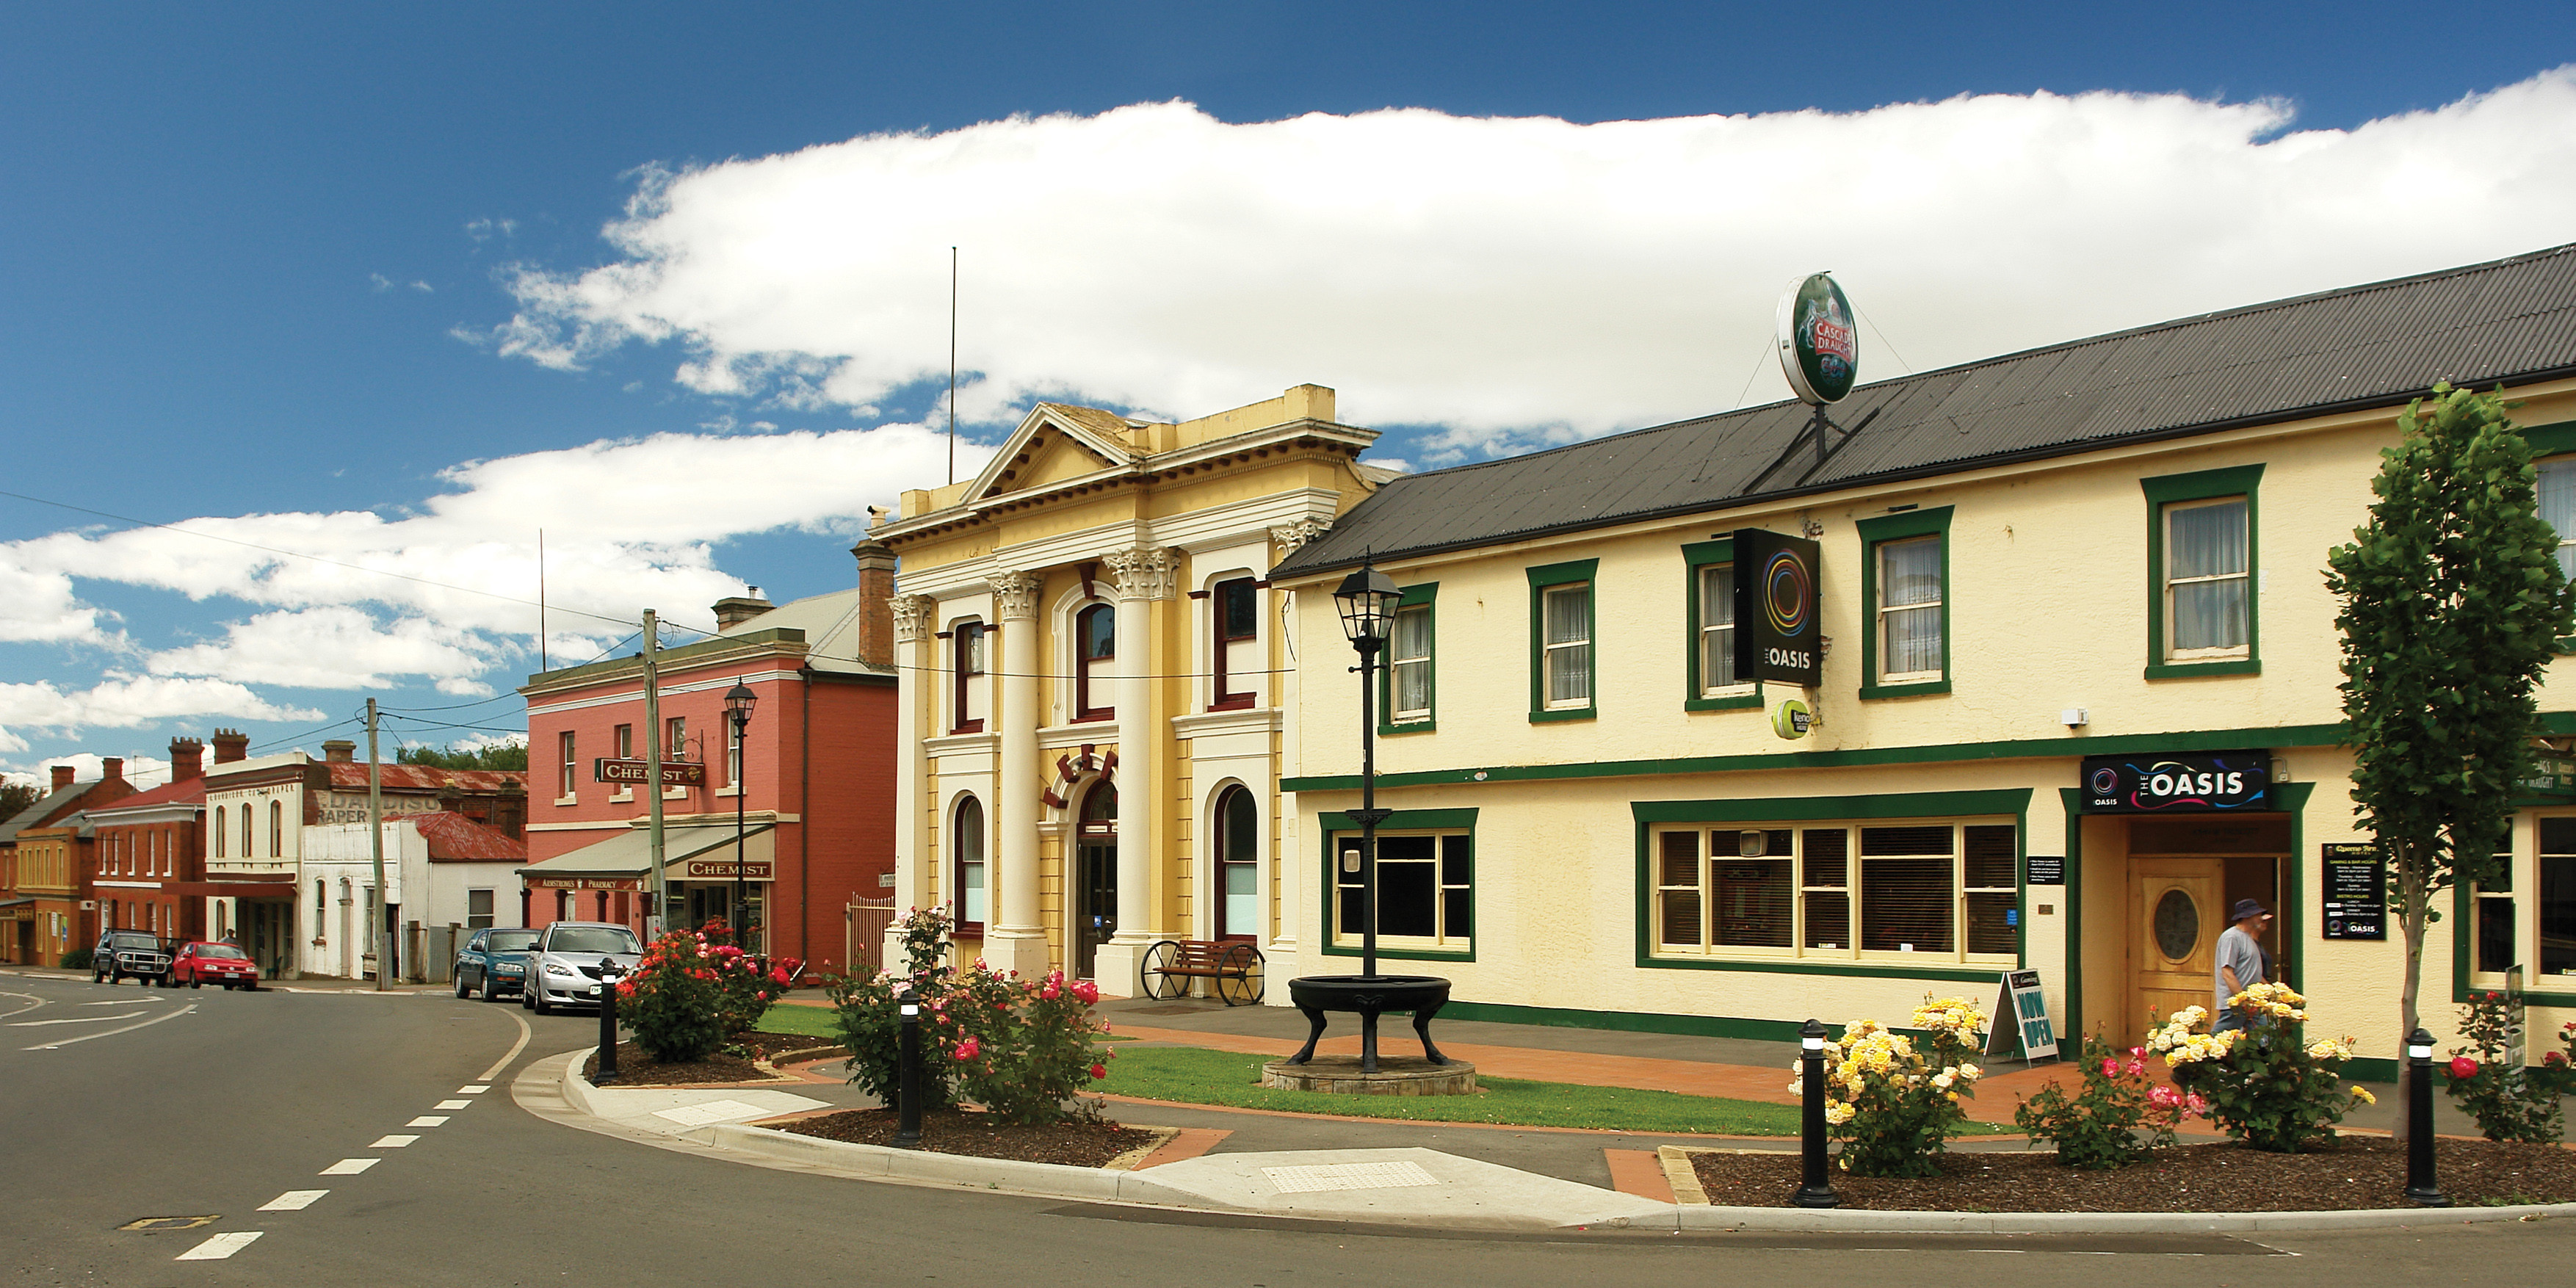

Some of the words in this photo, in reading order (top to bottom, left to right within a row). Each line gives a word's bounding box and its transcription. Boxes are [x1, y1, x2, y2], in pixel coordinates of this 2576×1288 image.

[1817, 323, 1851, 346] CASCADE
[1818, 336, 1851, 358] DRAUGHT
[1770, 648, 1810, 669] OASIS
[1794, 712, 1810, 723] keno
[607, 764, 683, 781] CHEST
[2141, 775, 2149, 796] THE
[2151, 772, 2243, 797] OASIS
[2017, 991, 2045, 1020] NOW
[2024, 1019, 2055, 1049] OPEN
